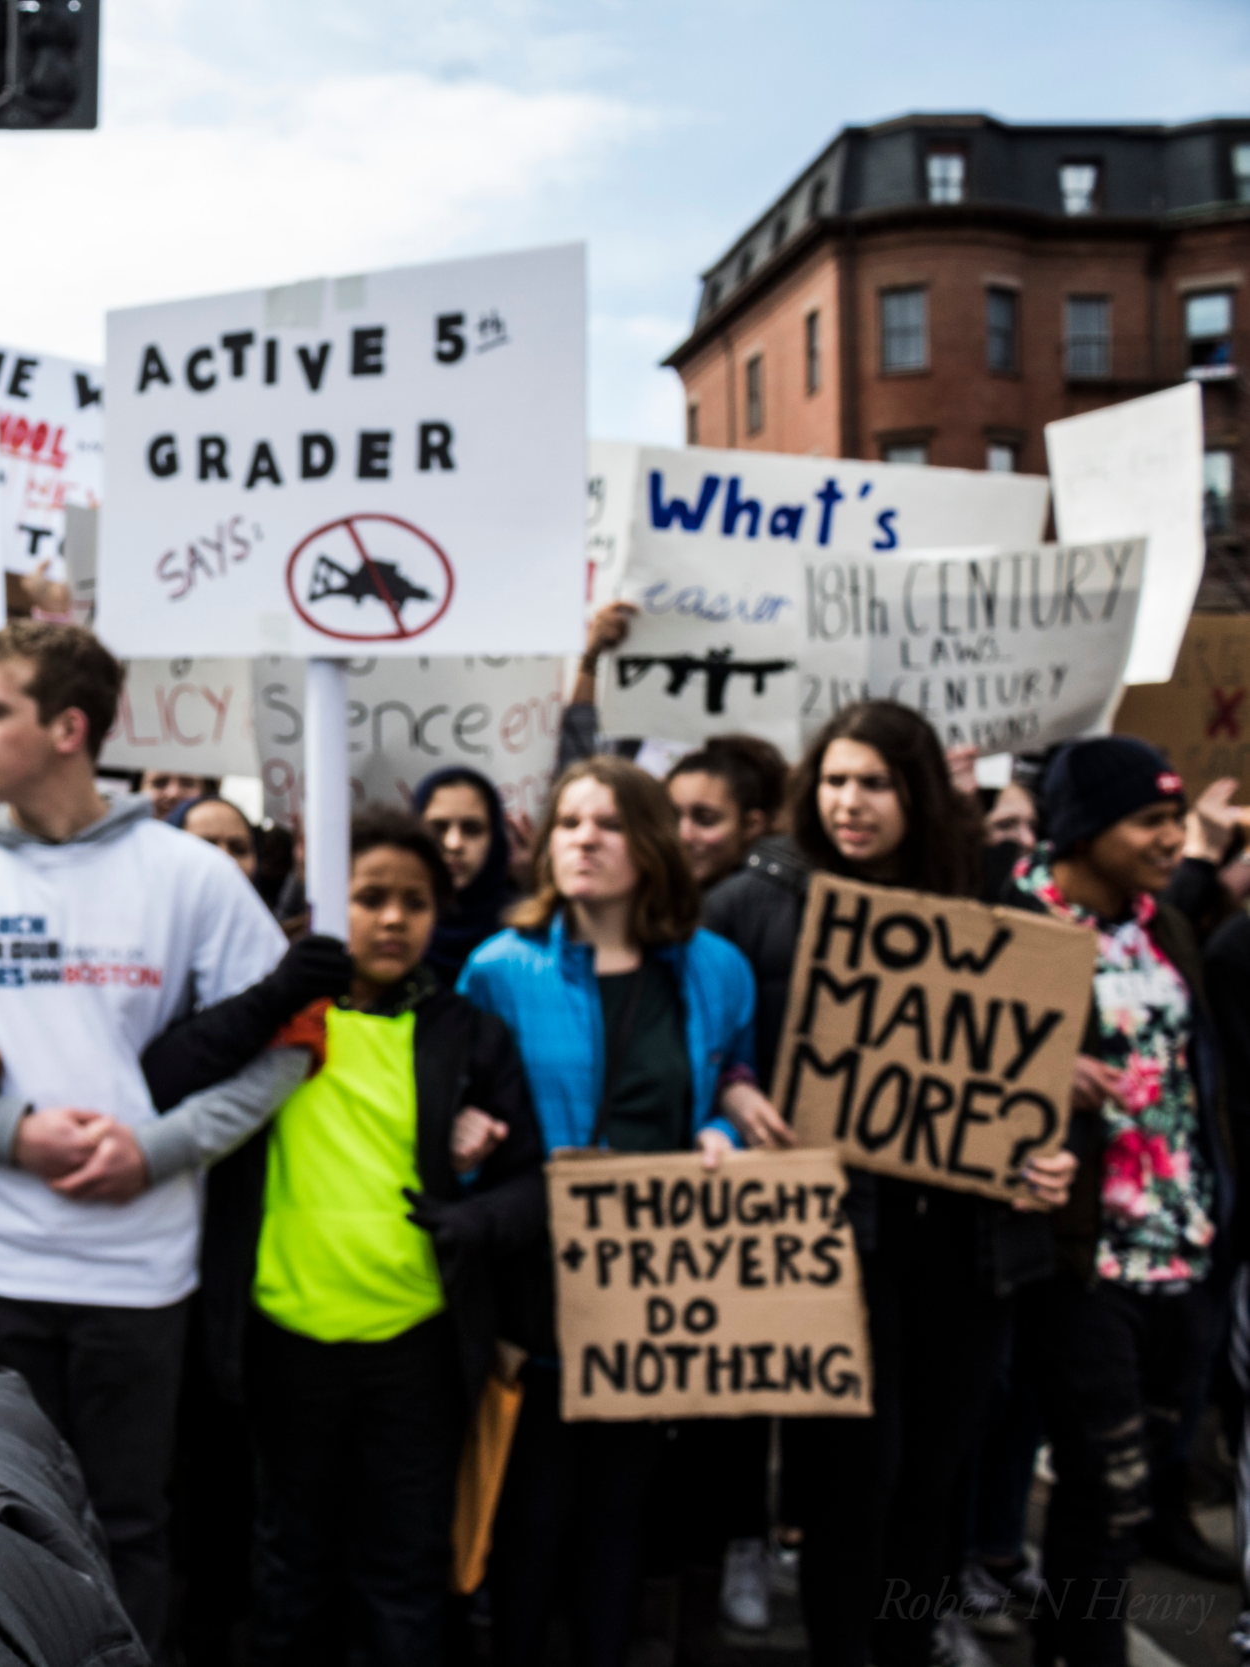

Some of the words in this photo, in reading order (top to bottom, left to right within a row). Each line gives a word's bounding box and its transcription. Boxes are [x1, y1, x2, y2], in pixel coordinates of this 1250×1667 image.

[136, 324, 387, 394] ACTIVE
[146, 420, 456, 490] GRADER
[648, 468, 901, 552] What's
[804, 560, 890, 641] 18th
[903, 541, 1135, 637] CENTURY
[105, 682, 234, 748] LICY
[813, 890, 1015, 975] HOW
[63, 961, 163, 989] BOSTON
[797, 966, 1066, 1082] MANY
[784, 1040, 1059, 1187] MORE?
[646, 1297, 719, 1336] DO
